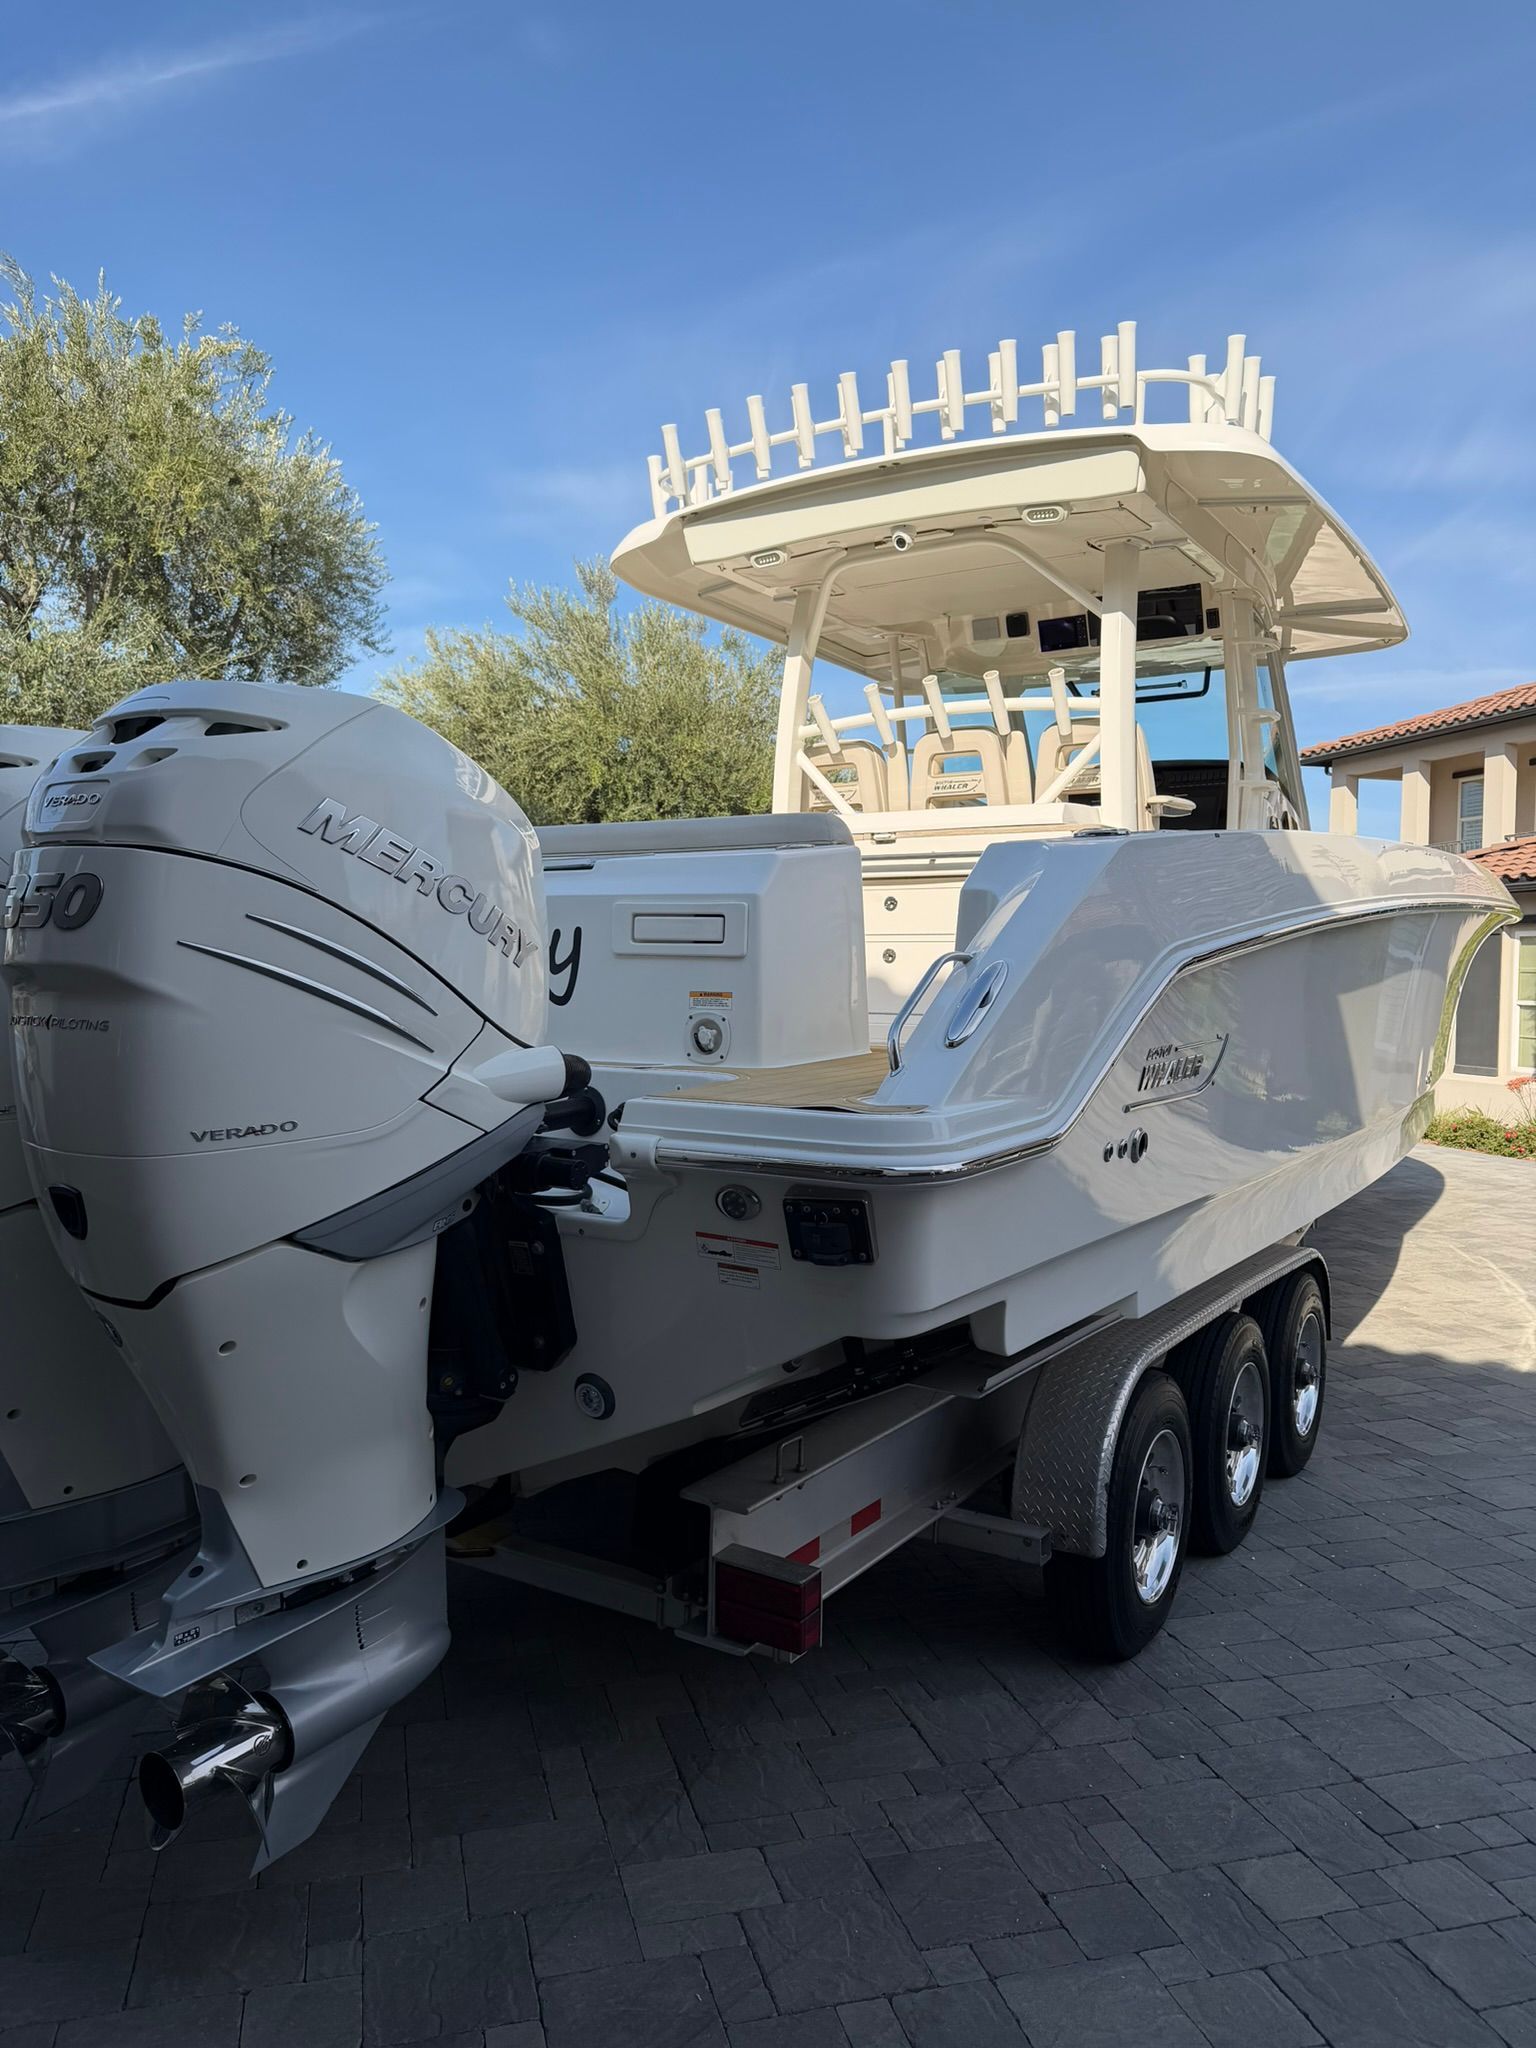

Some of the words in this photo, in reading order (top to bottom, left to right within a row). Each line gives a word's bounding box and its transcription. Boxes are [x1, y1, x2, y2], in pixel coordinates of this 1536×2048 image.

[44, 792, 102, 808] VERADO
[297, 797, 539, 968] MERCURY
[51, 1016, 110, 1032] PILOTING
[1137, 1053, 1205, 1093] WHALER
[190, 1120, 299, 1143] VERADO
